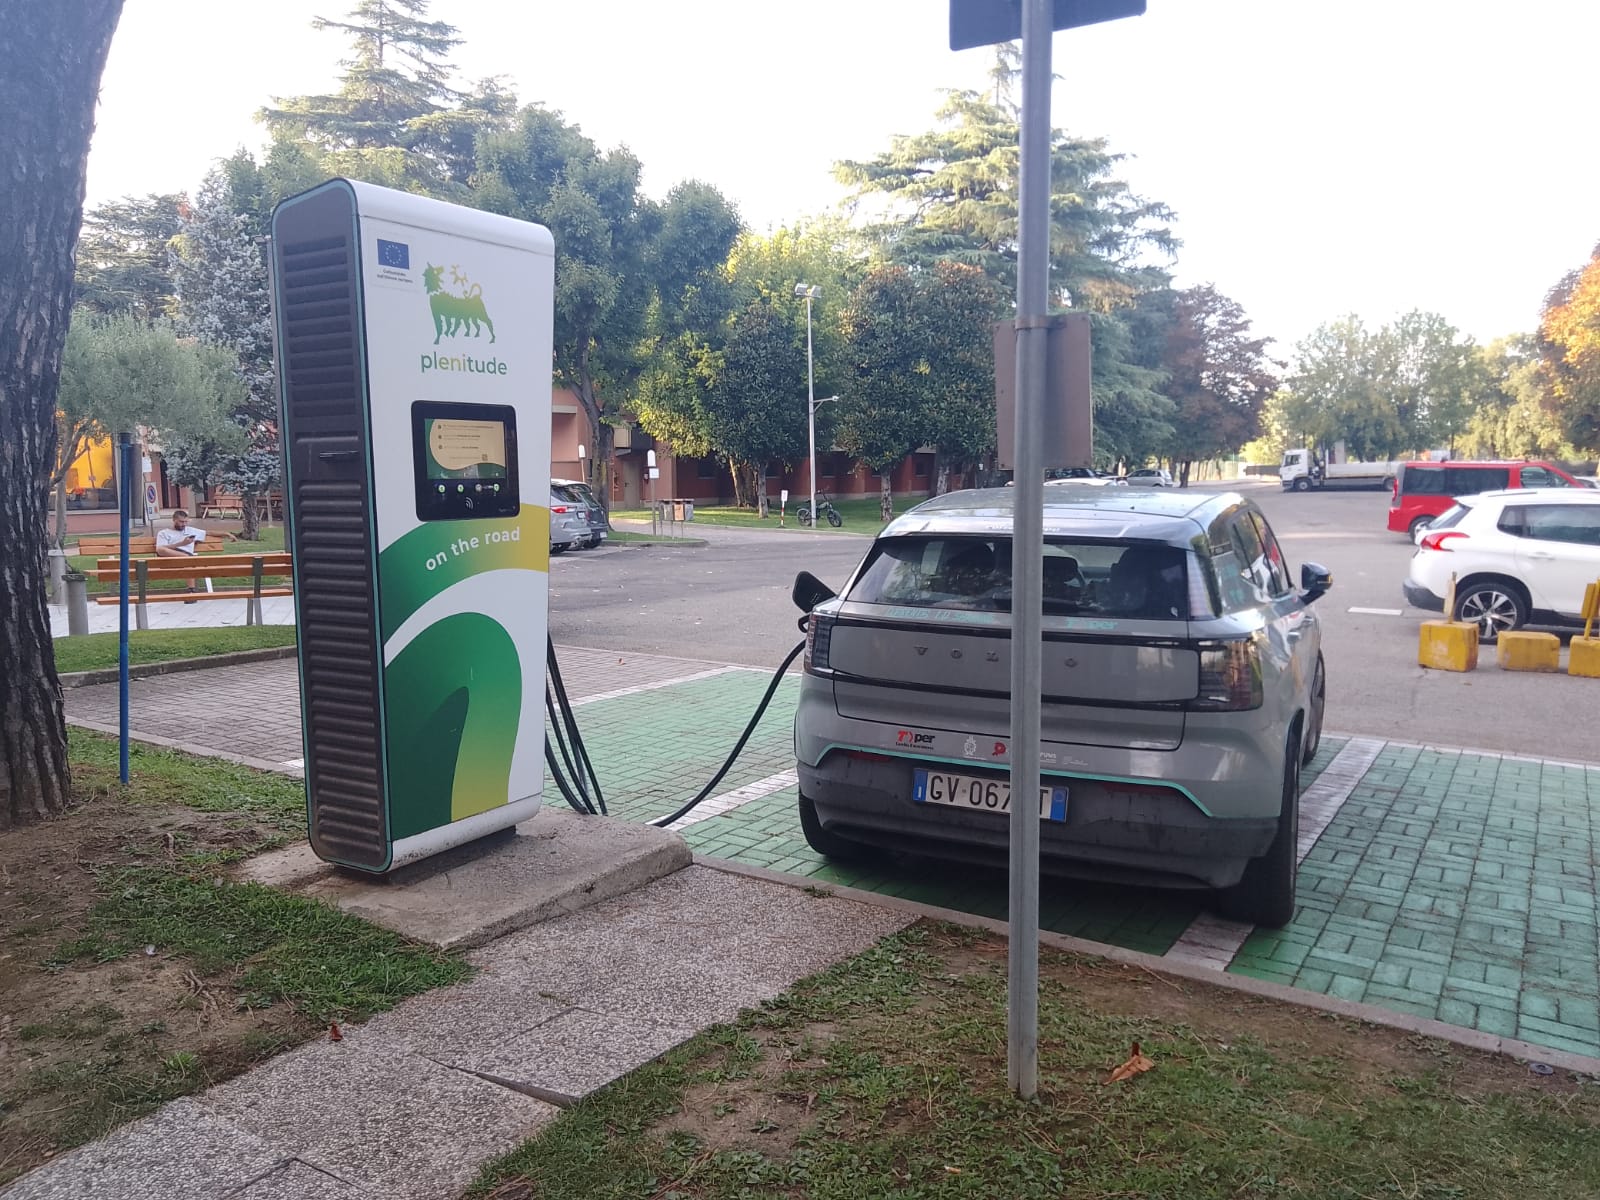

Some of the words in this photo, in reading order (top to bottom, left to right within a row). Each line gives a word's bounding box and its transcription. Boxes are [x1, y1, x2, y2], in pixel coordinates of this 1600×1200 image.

[420, 351, 508, 375] plenitude
[426, 550, 448, 571] on
[450, 536, 480, 556] the
[485, 527, 520, 545] road
[913, 645, 1079, 669] VOLO
[930, 775, 960, 803] GV
[969, 780, 1049, 815] 067T
